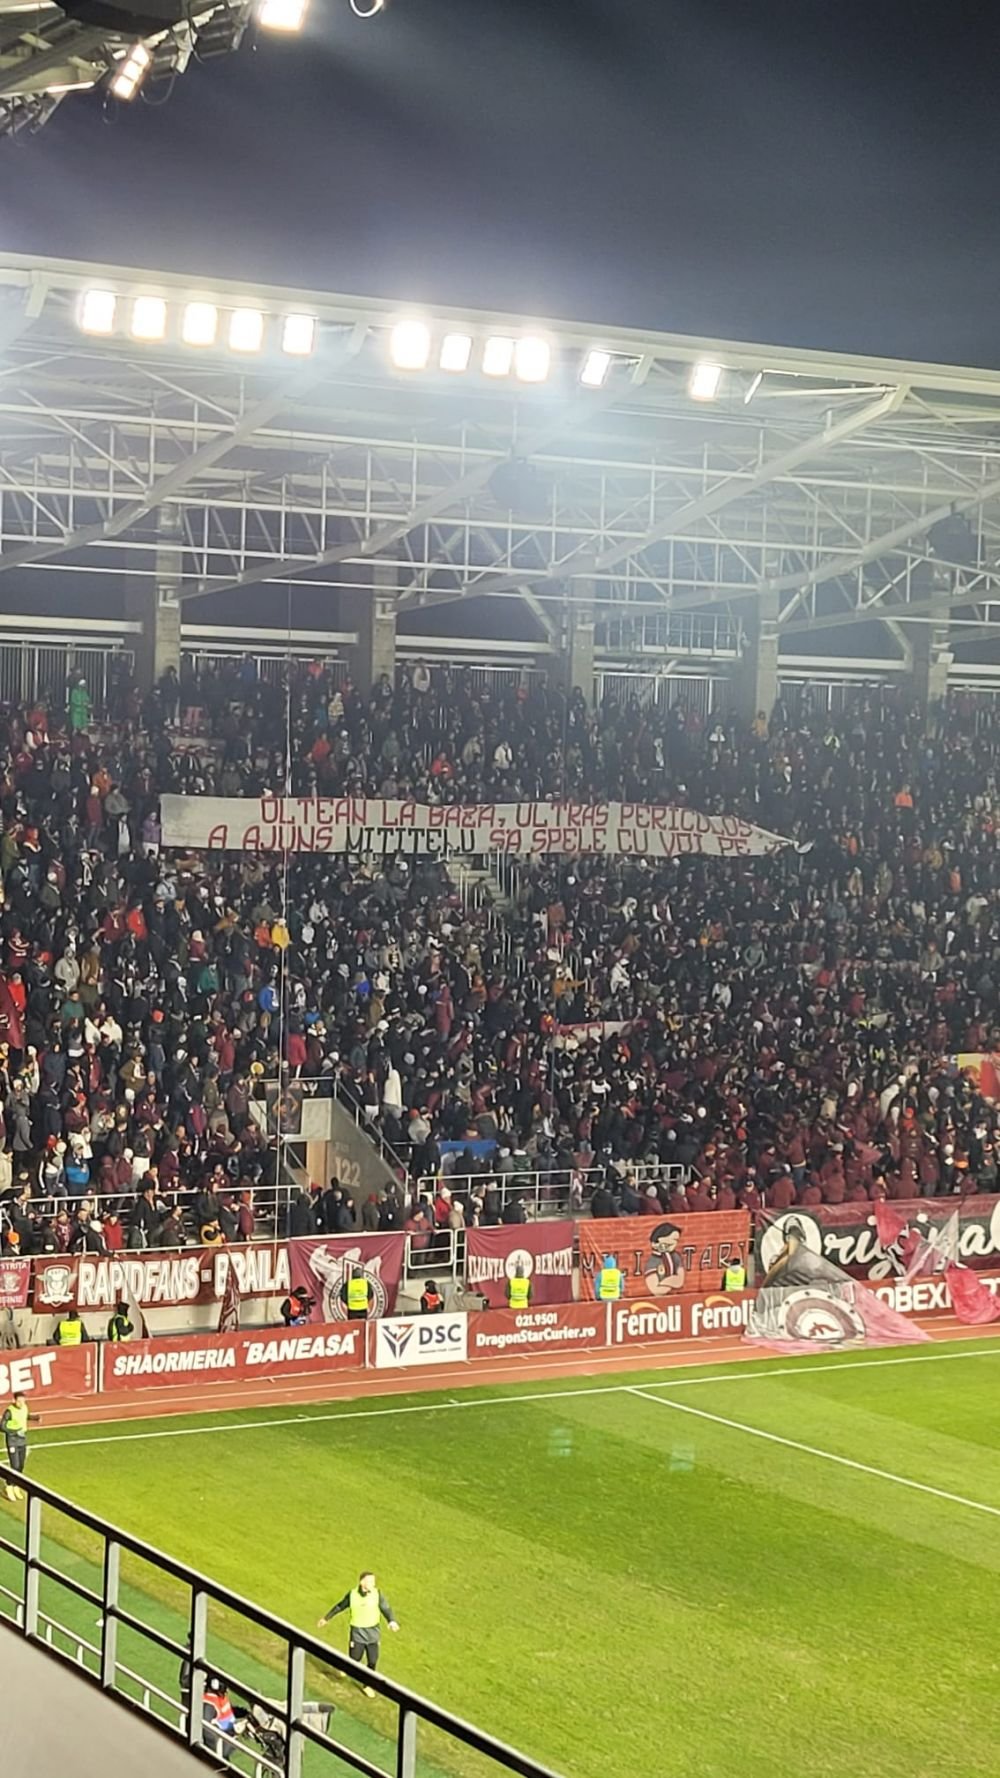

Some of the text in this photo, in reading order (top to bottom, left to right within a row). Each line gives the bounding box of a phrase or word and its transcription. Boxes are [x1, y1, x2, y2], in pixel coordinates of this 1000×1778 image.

[260, 797, 367, 825] OLTEAN
[382, 799, 417, 826] LA
[516, 802, 609, 828] ULTRAS
[208, 824, 228, 849] A
[242, 825, 333, 851] AJUNS
[345, 826, 475, 853] MITITELU
[532, 828, 607, 853] SPELE
[616, 829, 649, 853] CU
[660, 832, 703, 858] VOI
[718, 836, 751, 856] PE
[335, 1156, 361, 1187] 122
[77, 1257, 199, 1306] RAPIDFANS
[214, 1247, 291, 1298] BRAILA
[418, 1323, 462, 1345] DSC
[515, 1312, 558, 1328] 021.9501
[616, 1304, 681, 1342] Ferroli
[113, 1329, 360, 1376] SHAORMERIA "BANEASA"
[476, 1326, 596, 1348] DragonStarCurier.ro
